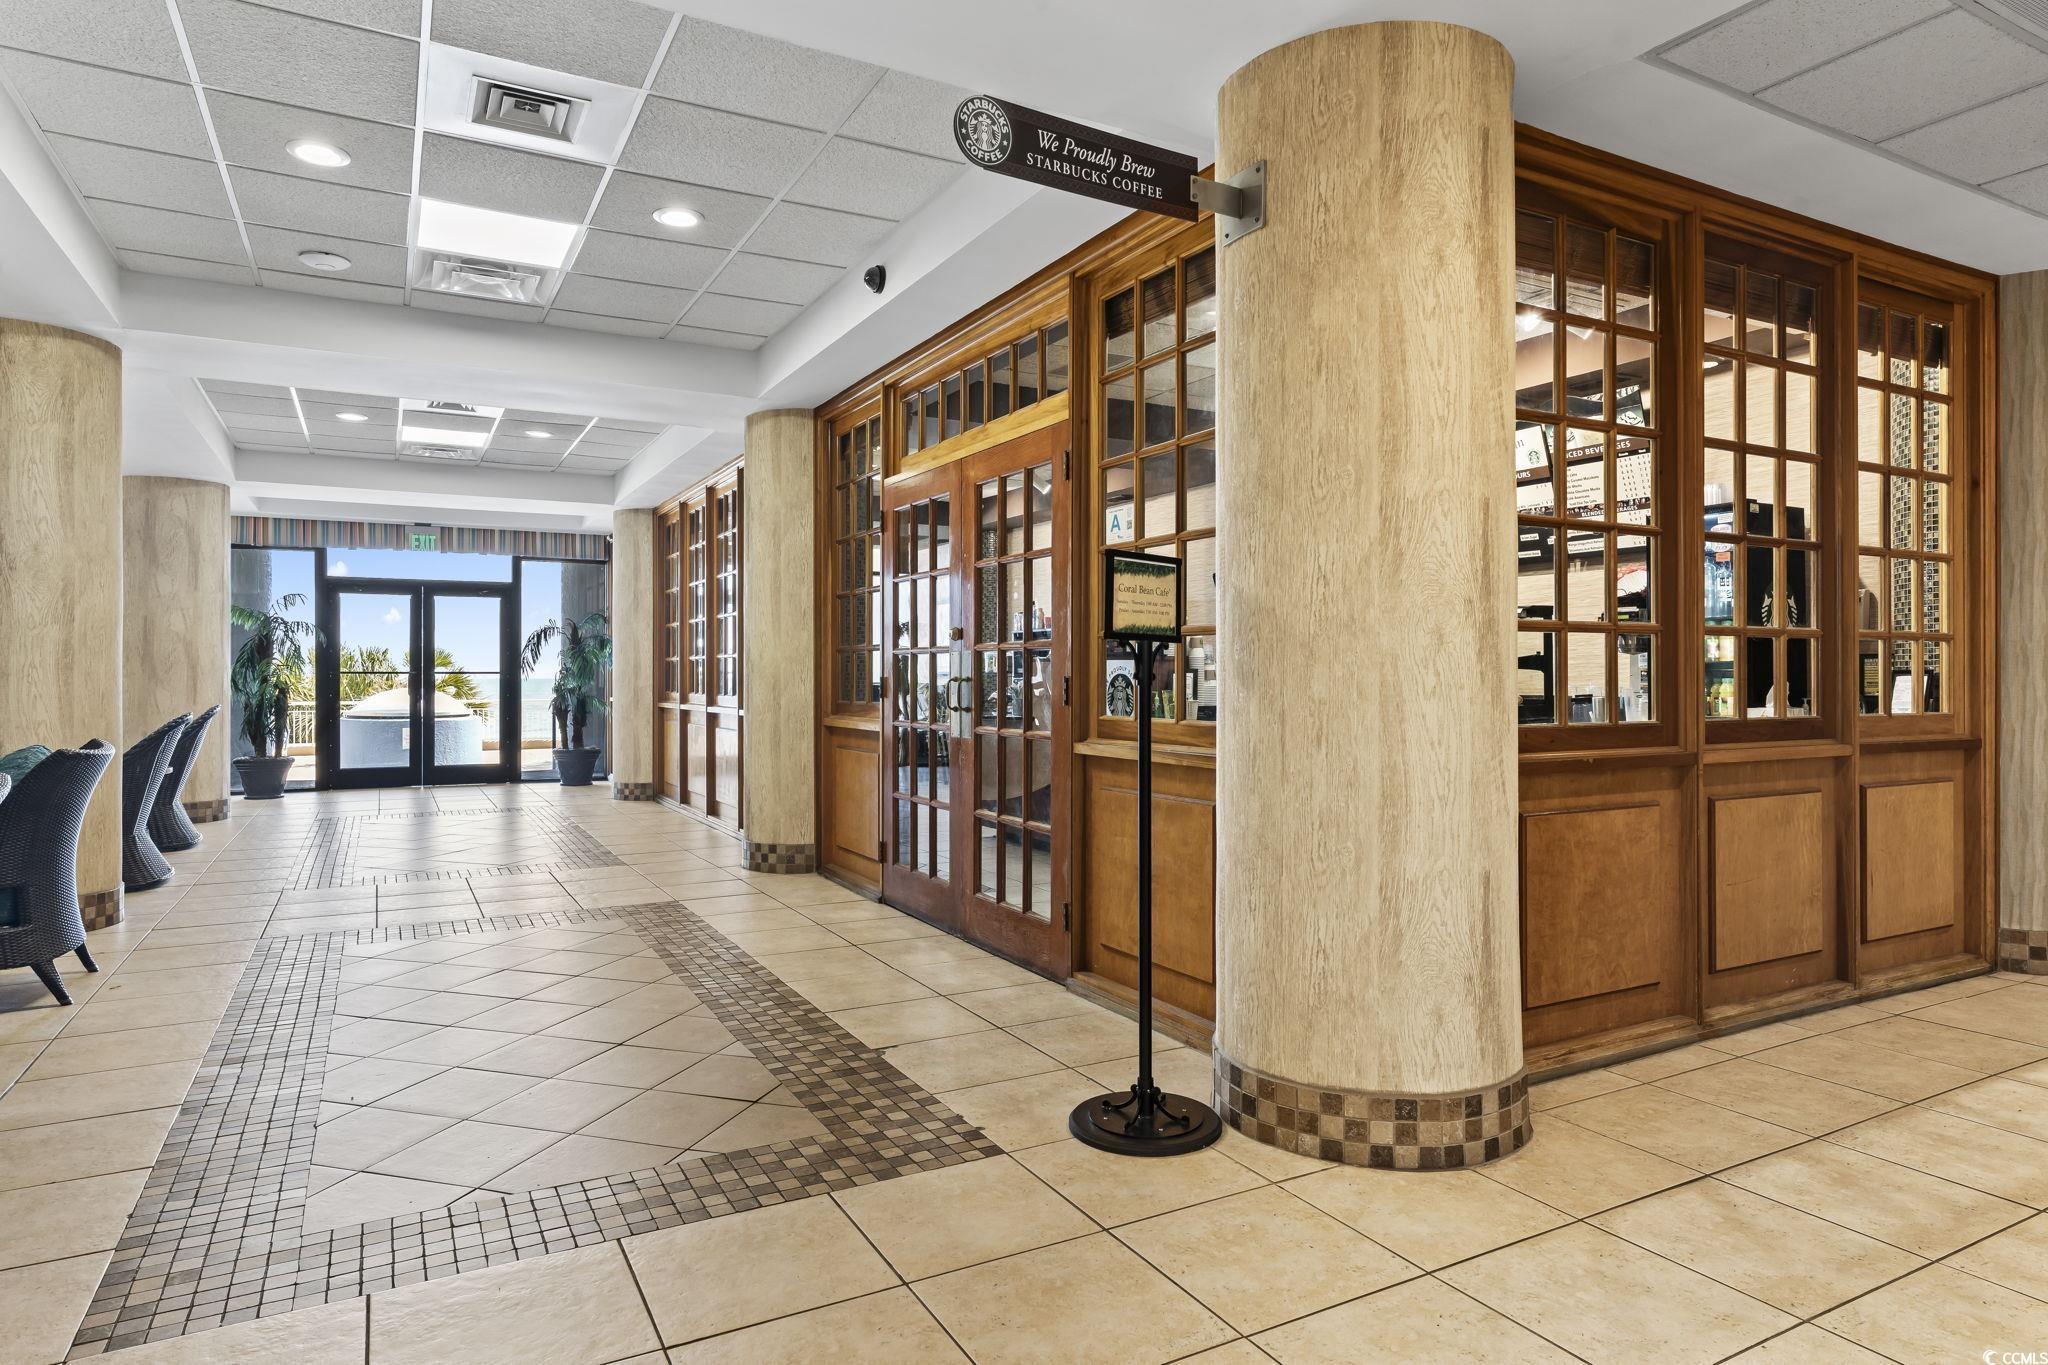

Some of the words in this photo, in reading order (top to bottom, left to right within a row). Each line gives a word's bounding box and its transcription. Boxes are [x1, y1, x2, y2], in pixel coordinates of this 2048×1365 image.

[960, 98, 1009, 134] STARBUCKS
[965, 139, 1003, 162] COFFEE
[1037, 129, 1059, 152] We
[1062, 137, 1117, 173] Proudly
[1120, 154, 1157, 179] Brew
[1026, 152, 1108, 186] STARBUCKS
[1112, 176, 1163, 200] COFFEE
[1110, 514, 1121, 533] A
[411, 534, 436, 552] EXIT
[1118, 583, 1137, 593] Coral
[1139, 585, 1154, 595] Bean
